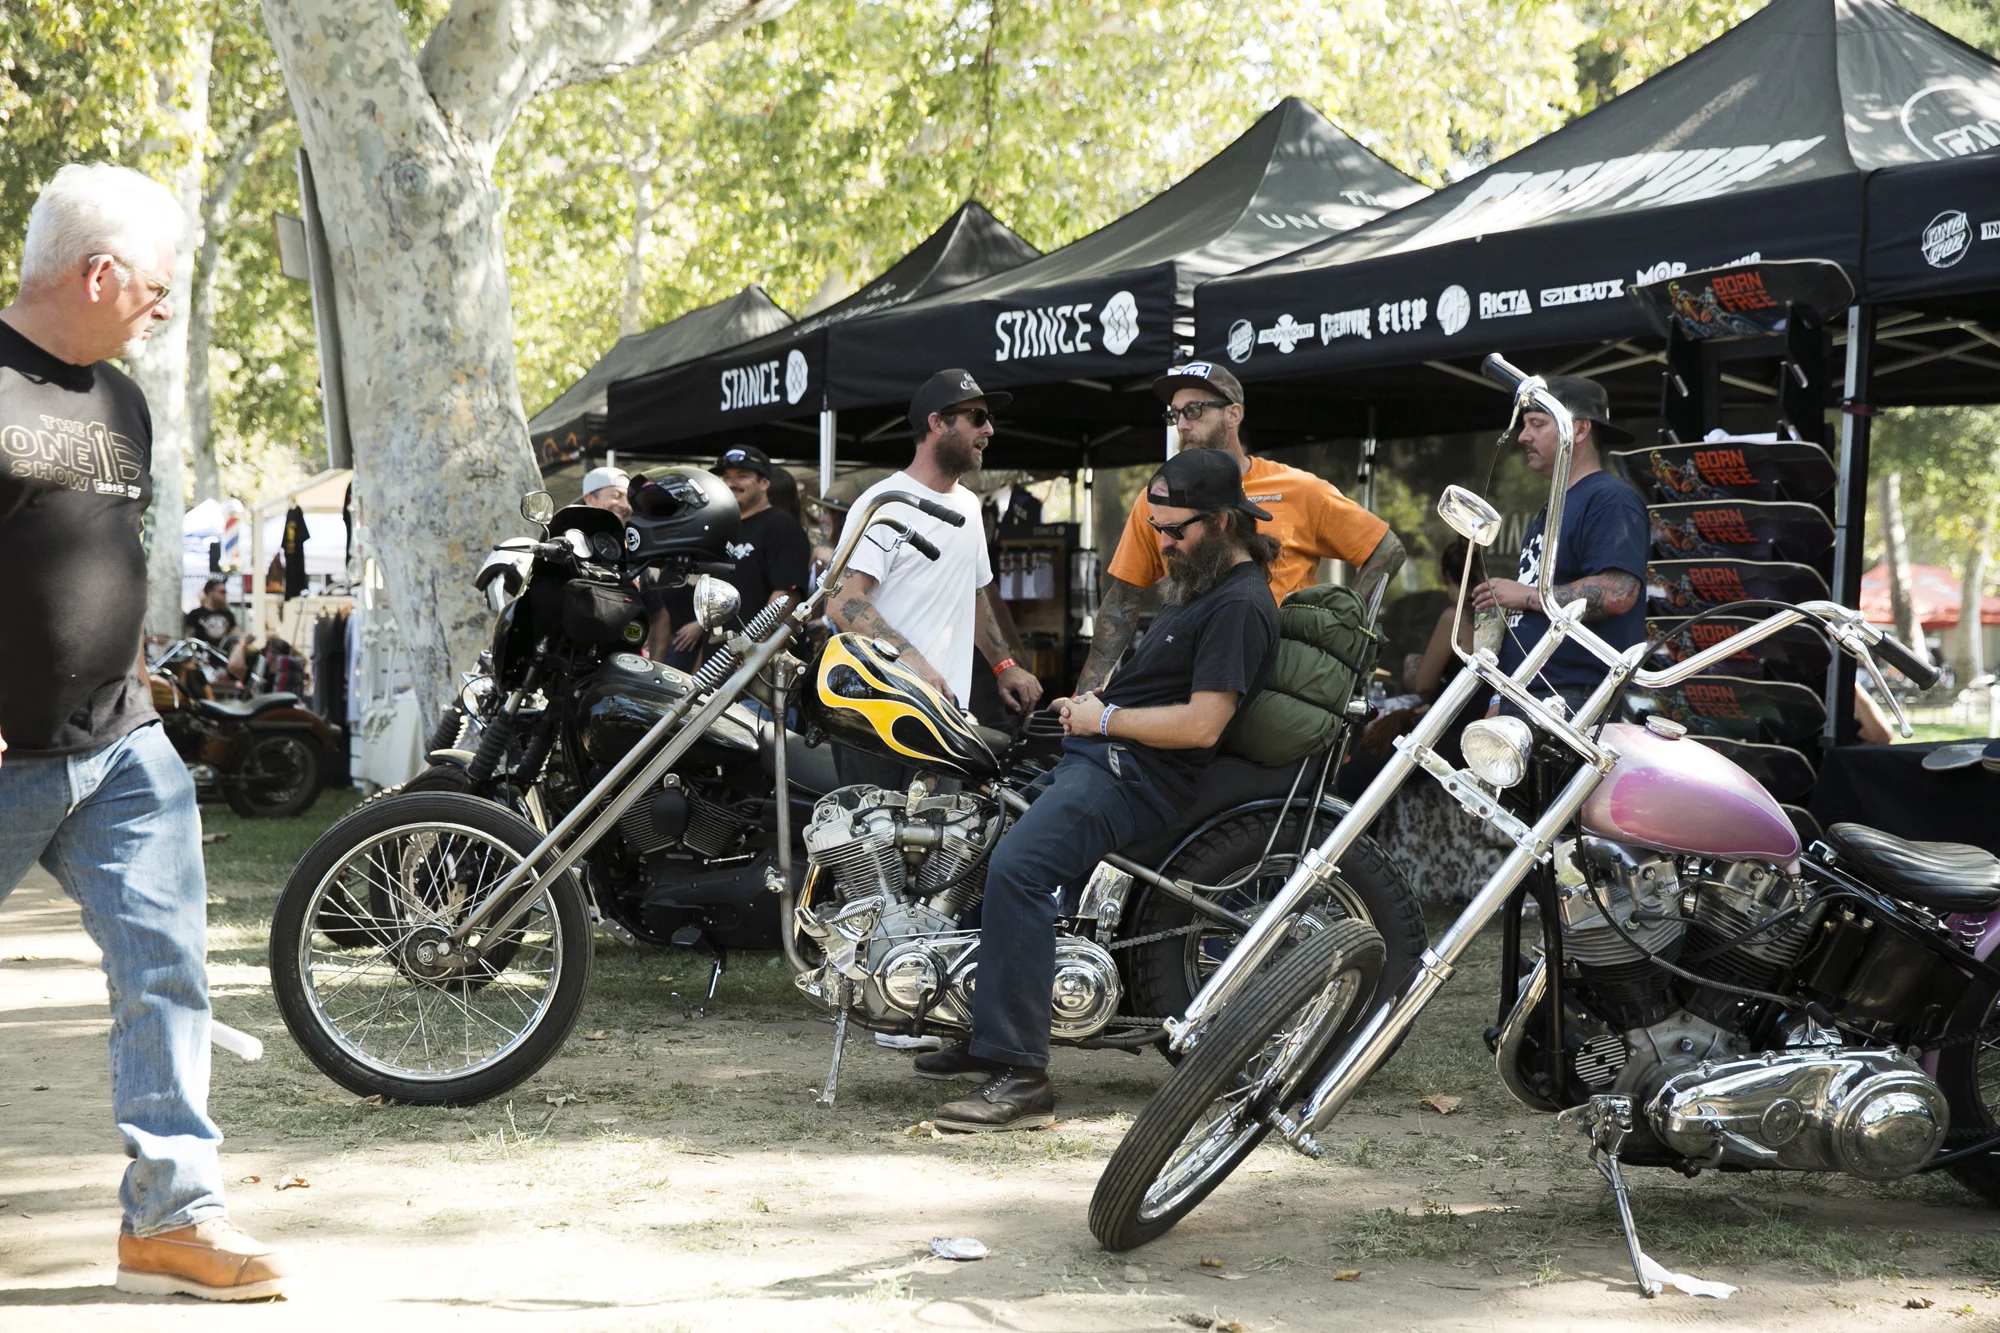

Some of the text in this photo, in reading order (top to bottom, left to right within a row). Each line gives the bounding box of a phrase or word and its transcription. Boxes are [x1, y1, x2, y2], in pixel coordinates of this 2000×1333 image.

[1562, 278, 1625, 305] KRUX
[1711, 270, 1764, 297] BORN
[1479, 288, 1533, 318] RICTA
[1722, 289, 1779, 314] FREE
[995, 303, 1093, 362] STANCE
[720, 360, 780, 411] STANCE
[40, 414, 86, 438] THE
[1, 425, 95, 475] ONE
[1694, 449, 1746, 470] BORN
[10, 459, 90, 492] SHOW
[1703, 467, 1760, 486] FREE
[97, 482, 125, 494] 2015
[1692, 508, 1745, 529] BORN
[1702, 526, 1760, 545] FREE
[1688, 567, 1741, 587] BORN
[1698, 584, 1755, 602] FREE
[1684, 684, 1737, 706] BORN
[1694, 702, 1751, 720] FREE
